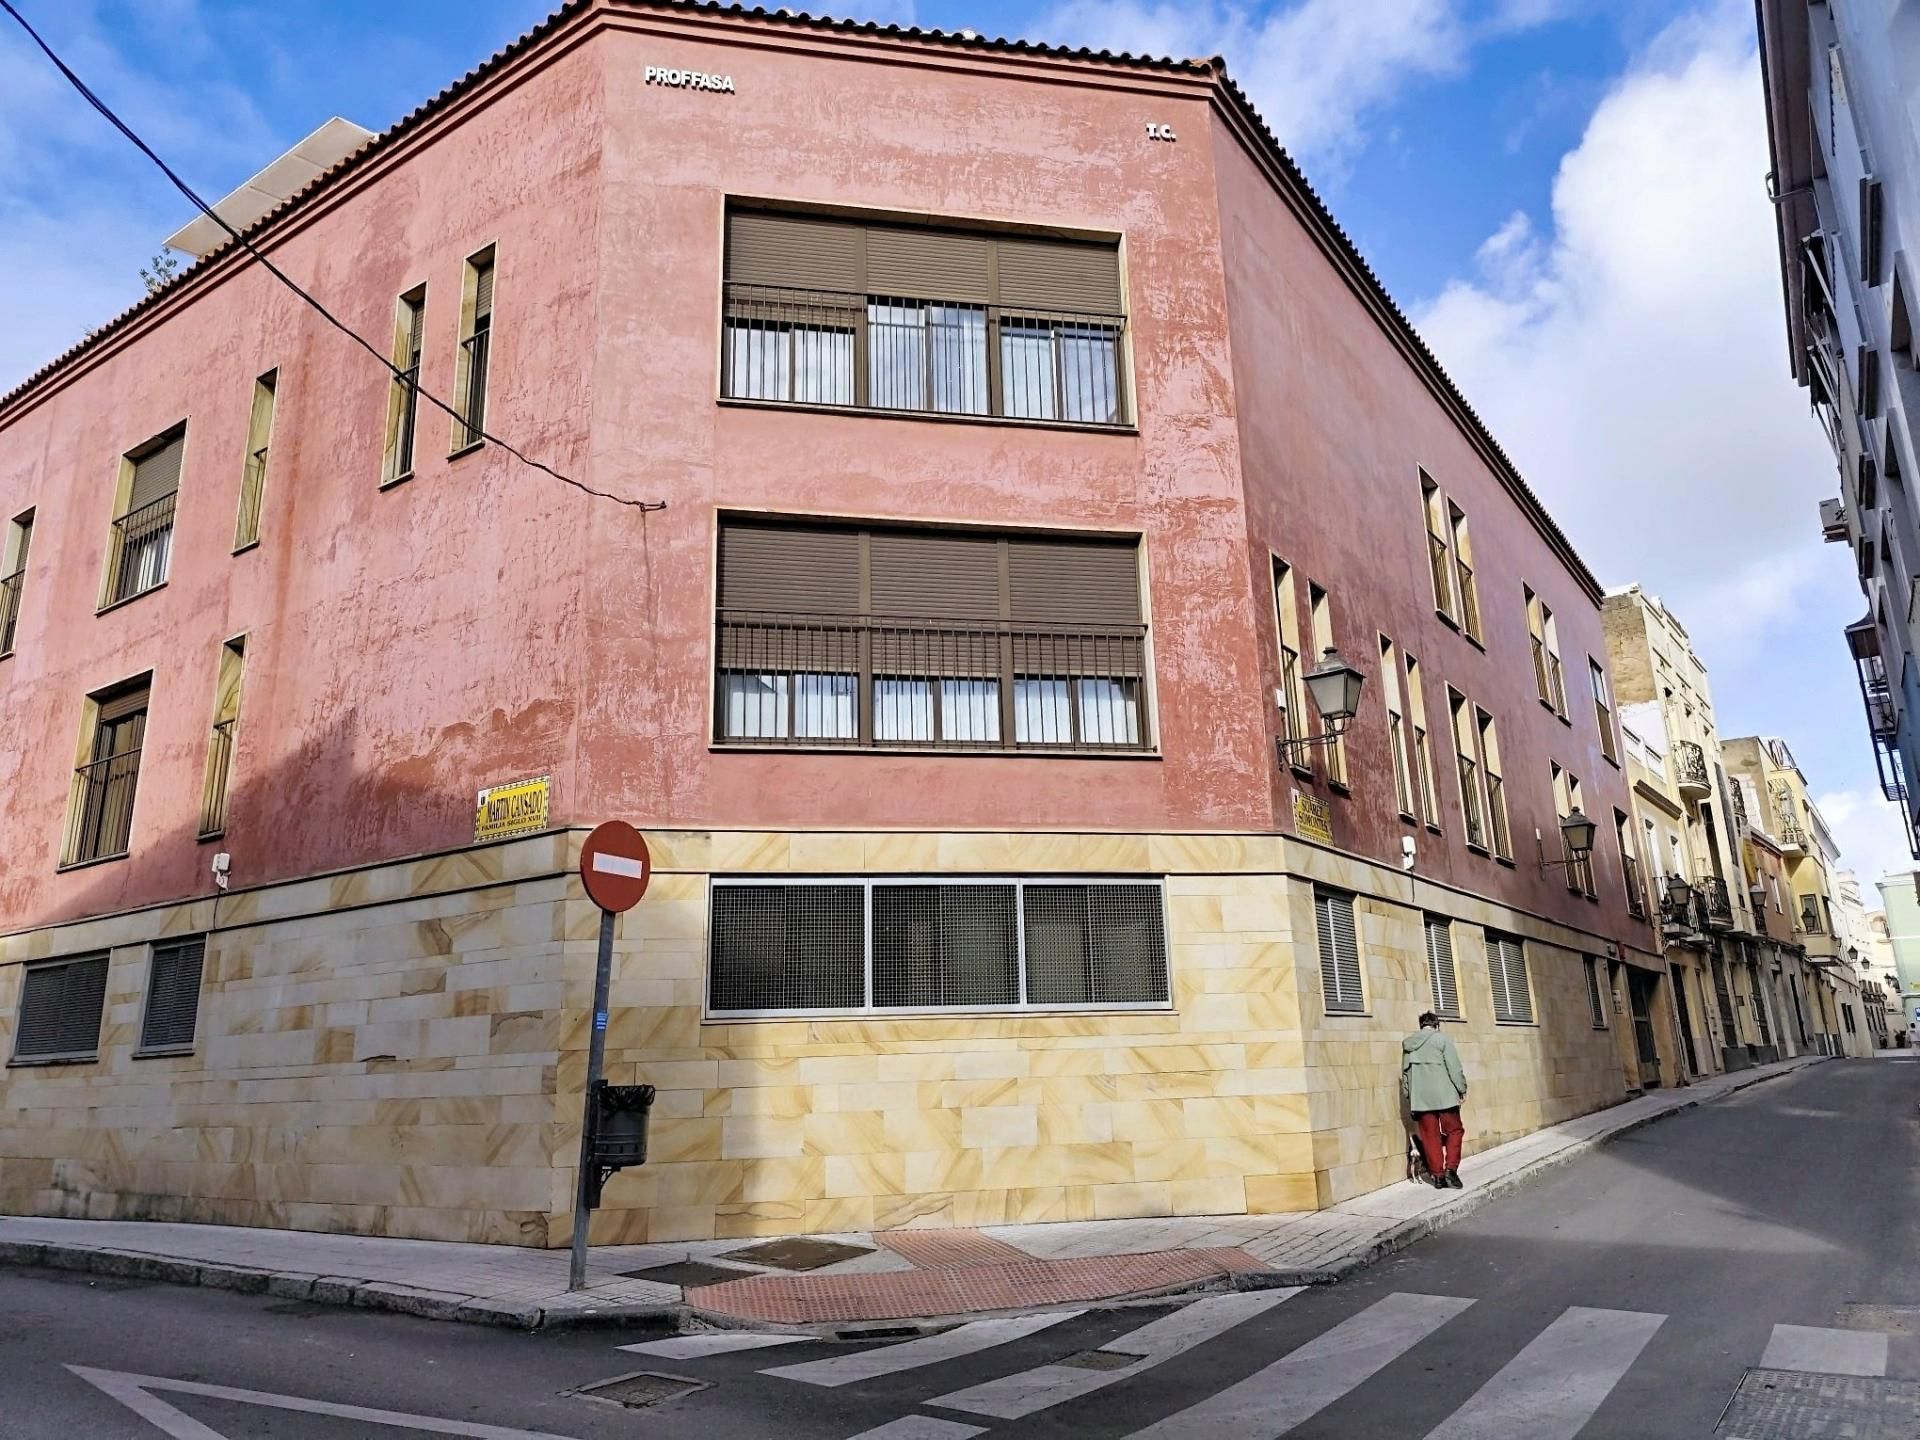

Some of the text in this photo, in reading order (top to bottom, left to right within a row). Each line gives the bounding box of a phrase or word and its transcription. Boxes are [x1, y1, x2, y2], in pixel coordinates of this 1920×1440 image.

[645, 65, 735, 92] PROFFASA
[487, 789, 543, 823] MARTIN CANSADO
[481, 821, 506, 832] FAMILIA
[507, 817, 527, 827] SIGLO
